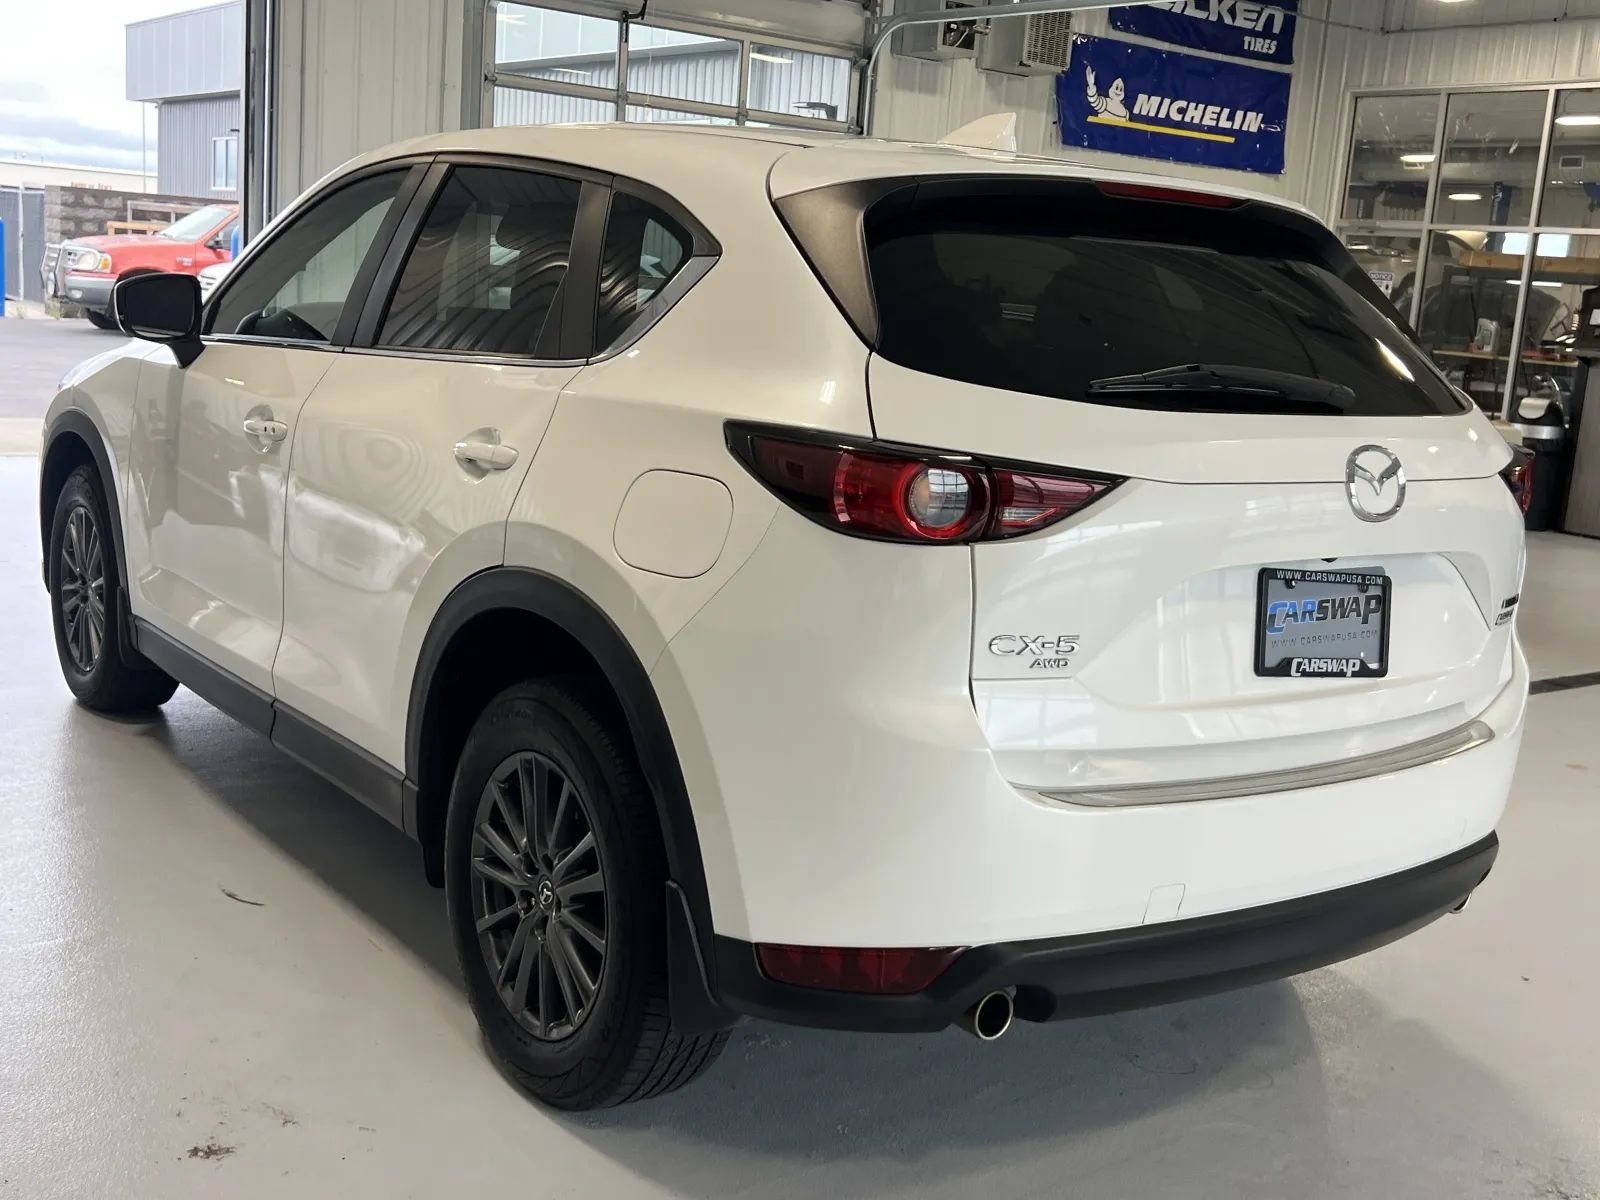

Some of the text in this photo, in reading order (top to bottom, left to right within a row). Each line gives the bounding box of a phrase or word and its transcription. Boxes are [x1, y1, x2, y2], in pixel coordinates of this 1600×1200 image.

[1243, 36, 1278, 54] TIRES
[1133, 93, 1264, 132] MICHELIN
[1277, 569, 1383, 585] WWW.CARSWAPUSA.COM
[1266, 594, 1382, 635] CARSWAP
[988, 634, 1080, 656] CX-5
[1028, 658, 1071, 669] AWD
[1290, 657, 1361, 677] CARSWAP
